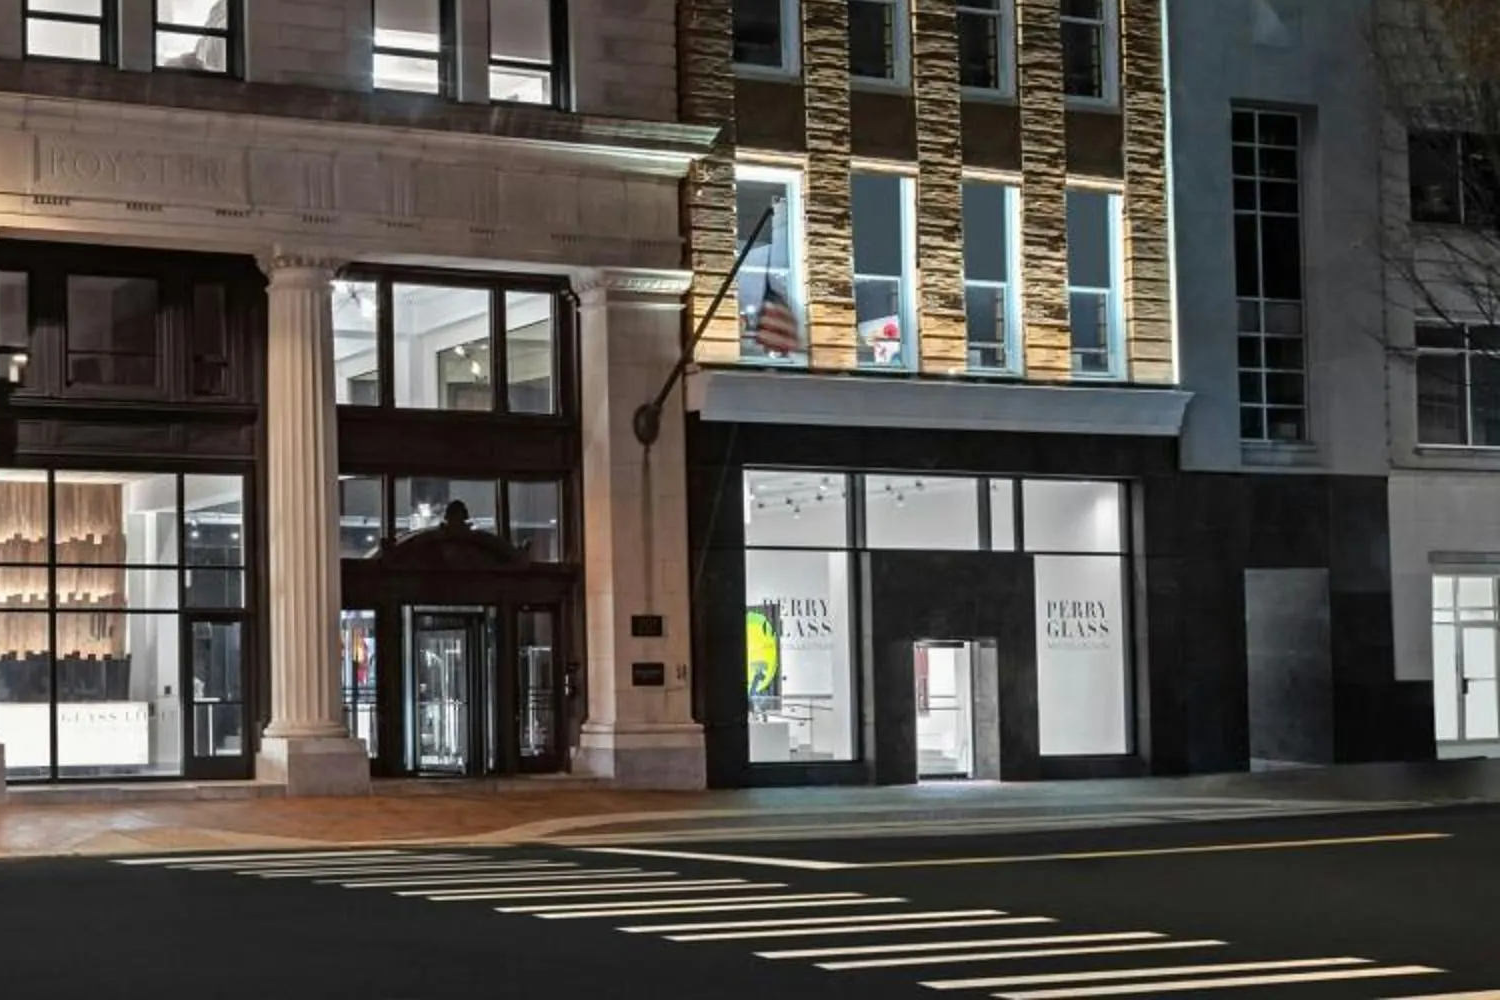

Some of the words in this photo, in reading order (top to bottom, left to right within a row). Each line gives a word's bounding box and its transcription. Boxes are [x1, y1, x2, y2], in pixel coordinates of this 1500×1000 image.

[50, 149, 226, 187] ROYSTER
[1047, 601, 1107, 618] PERRY
[1047, 620, 1109, 637] GLASS
